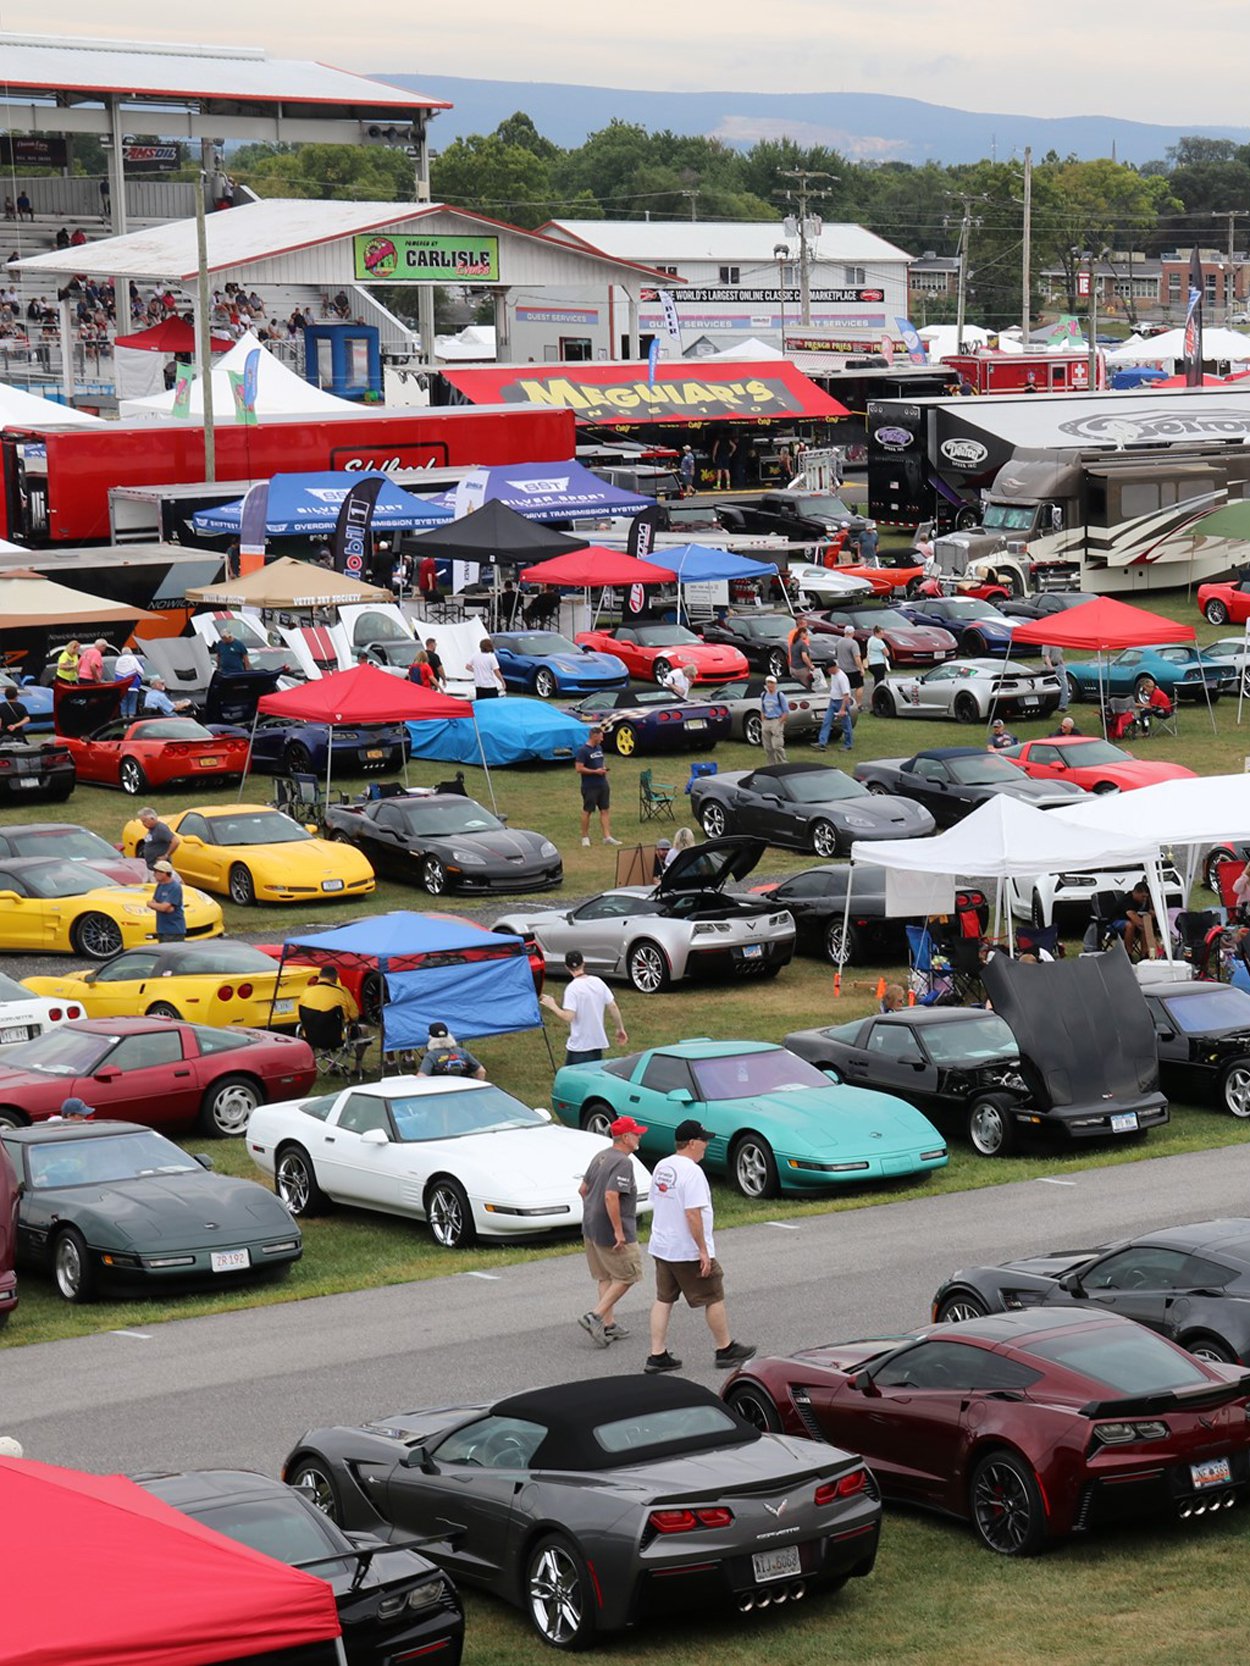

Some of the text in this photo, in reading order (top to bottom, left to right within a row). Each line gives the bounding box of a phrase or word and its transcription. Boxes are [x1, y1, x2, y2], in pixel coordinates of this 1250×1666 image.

[126, 146, 176, 160] AMSOIL
[406, 250, 490, 267] CARLISLE
[675, 289, 708, 301] WORLD'S
[708, 289, 738, 301] LARGEST
[739, 289, 764, 301] ONLINE
[764, 289, 793, 301] CLASSIC
[809, 289, 857, 301] MARKETPLACE
[526, 312, 587, 322] GUEST SERVICES
[664, 305, 678, 334] BEER
[684, 319, 732, 328] SERVICES
[822, 319, 869, 328] SERVICES
[804, 340, 831, 351] FRENCH
[831, 341, 852, 352] FRIES
[520, 378, 775, 410] MEGUIAR'S
[944, 441, 984, 461] Detroit
[524, 481, 562, 492] SST
[323, 490, 351, 501] SS
[557, 493, 606, 502] SPORT
[296, 506, 342, 514] SILVE
[549, 507, 610, 518] TRANSMISSION
[611, 504, 649, 514] SYSTEMS
[369, 518, 412, 528] SMISSION
[414, 516, 455, 526] SYSTEMS
[333, 593, 362, 603] SOCIETY
[216, 1253, 244, 1266] ZR 192
[756, 1526, 800, 1539] CORVETTE
